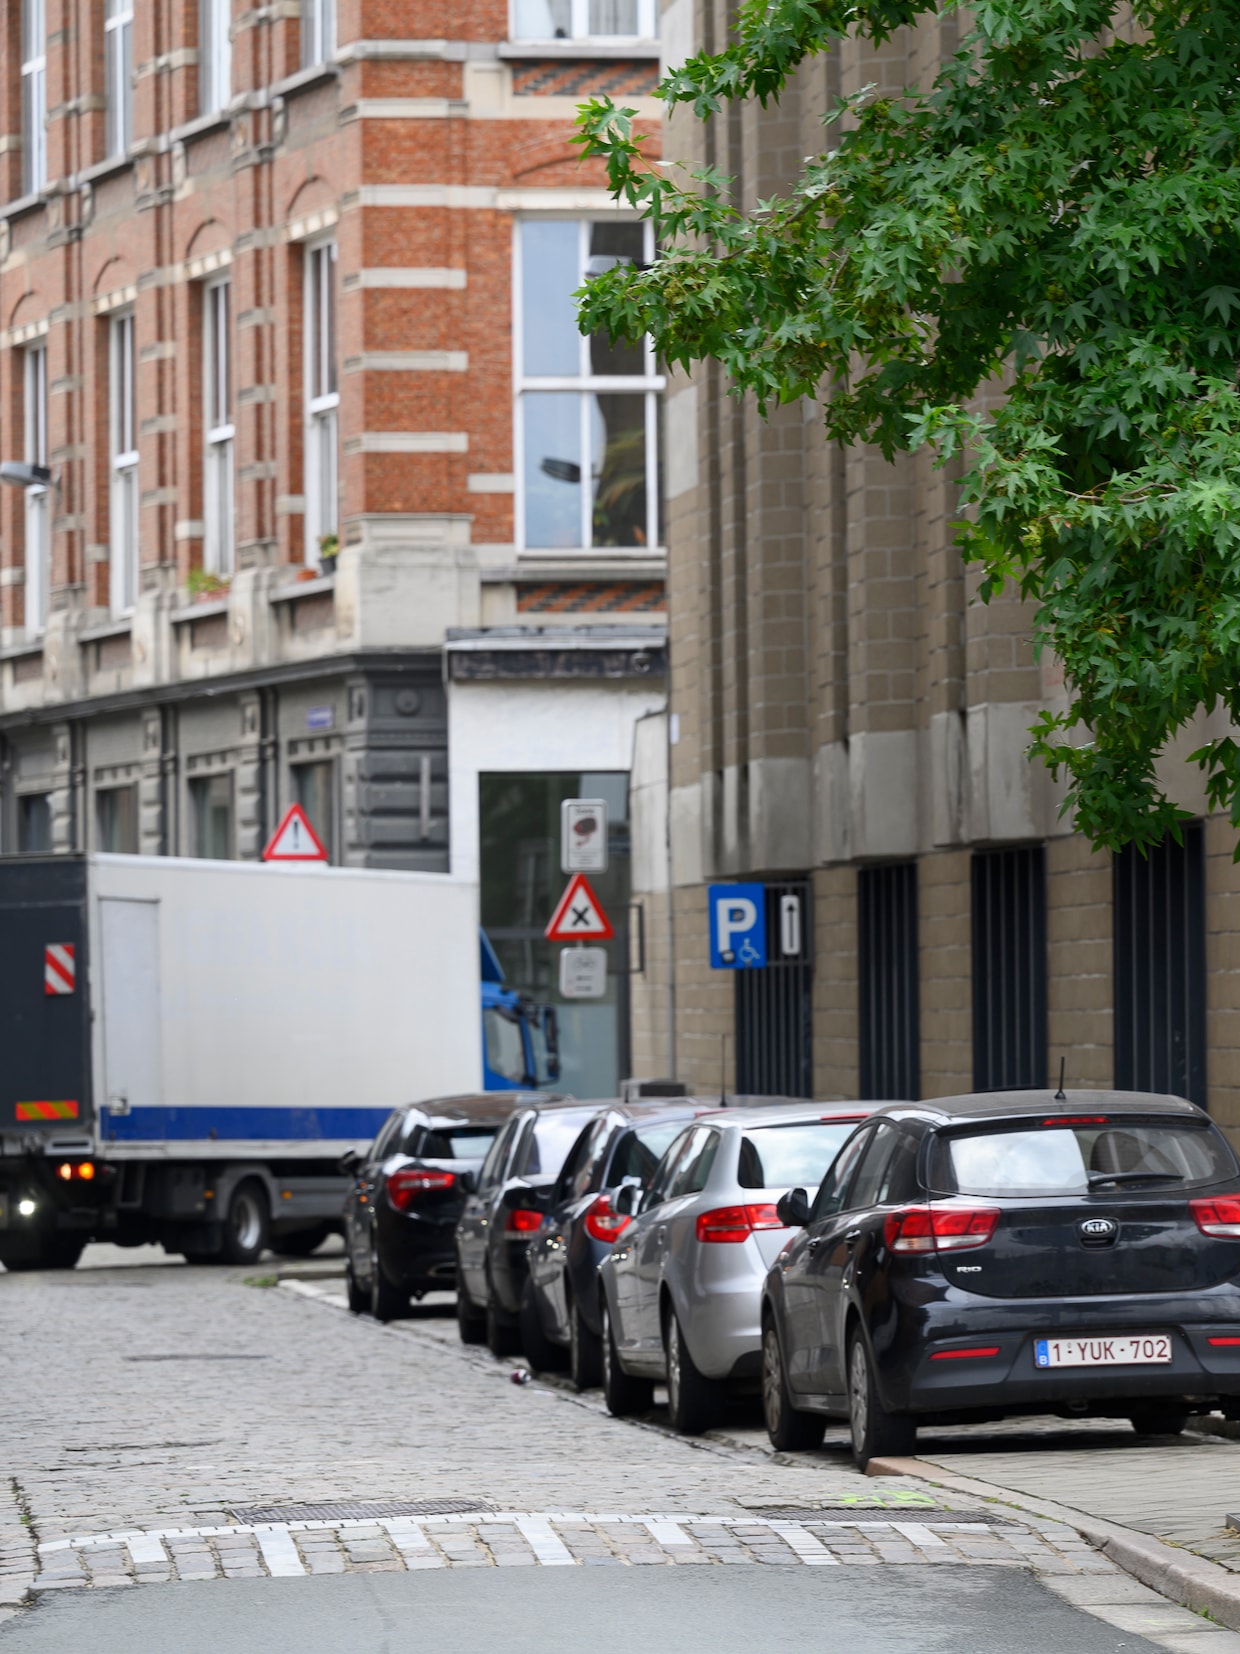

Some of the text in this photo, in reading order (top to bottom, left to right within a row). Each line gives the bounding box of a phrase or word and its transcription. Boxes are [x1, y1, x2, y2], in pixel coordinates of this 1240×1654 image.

[716, 897, 757, 956] P
[1085, 1221, 1110, 1234] KIA
[1052, 1339, 1168, 1362] 1-YUK-702
